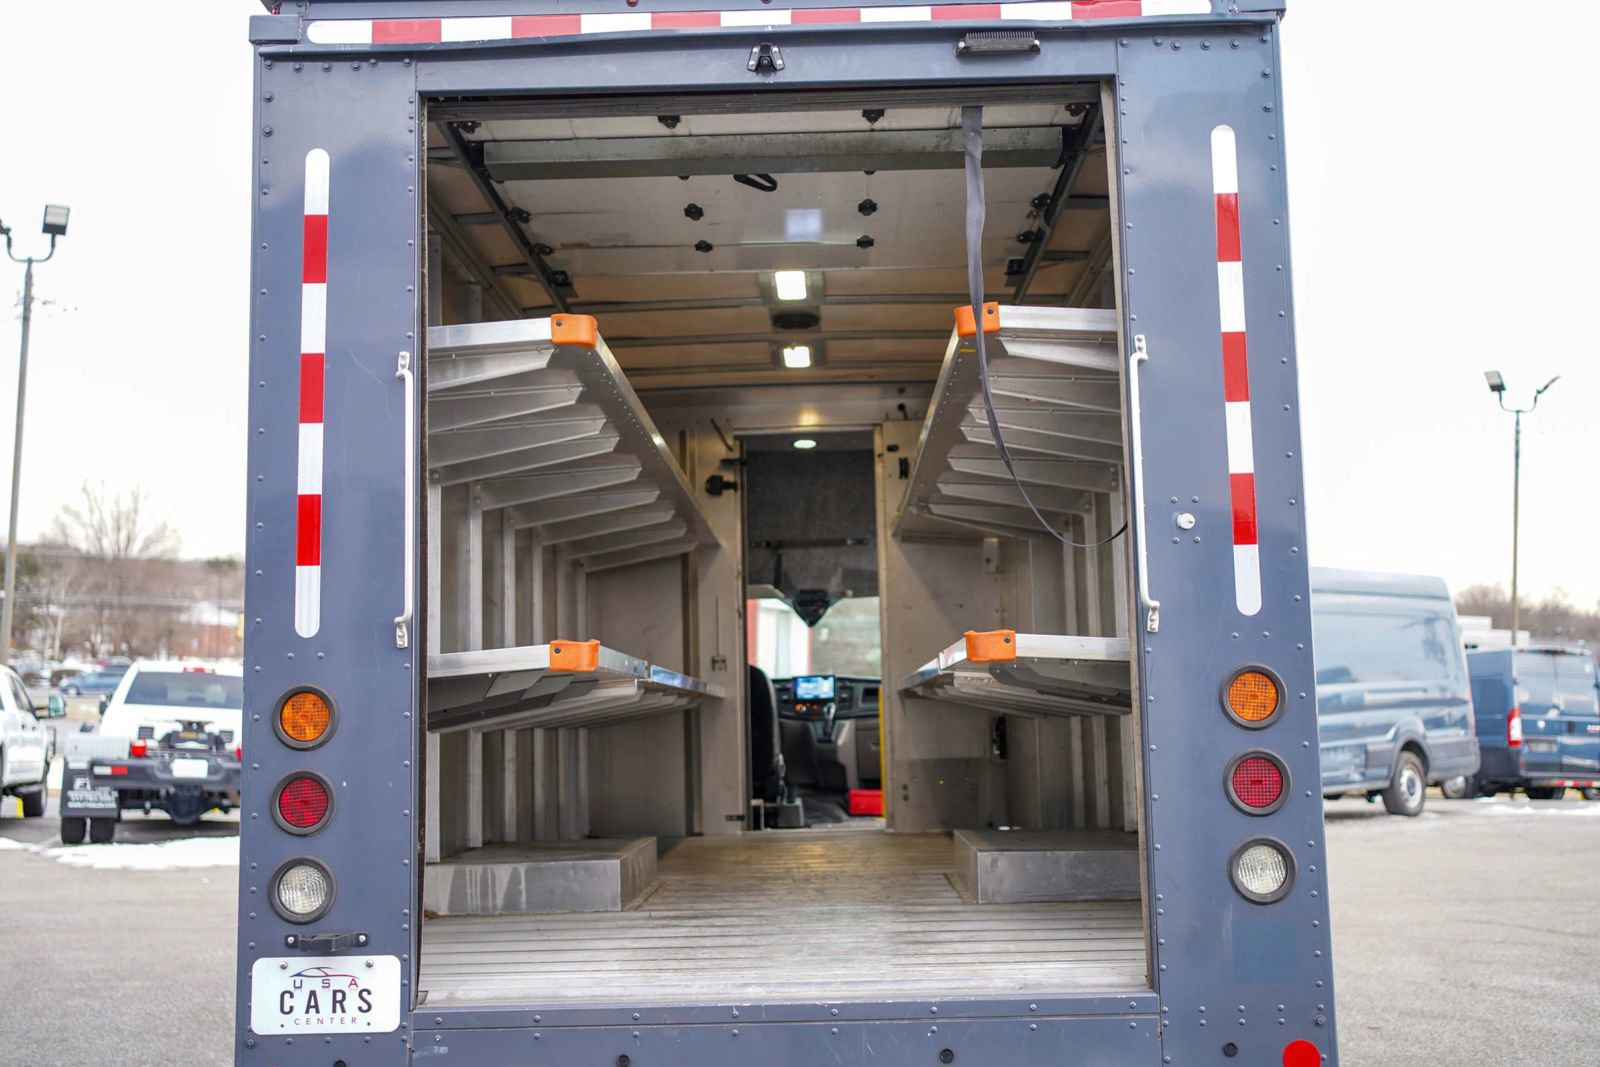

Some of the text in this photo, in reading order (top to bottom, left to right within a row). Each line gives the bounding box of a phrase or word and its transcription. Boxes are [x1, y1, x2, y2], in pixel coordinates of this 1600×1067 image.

[293, 978, 359, 989] USA
[279, 988, 373, 1015] CARS
[294, 1017, 357, 1026] CENTER
